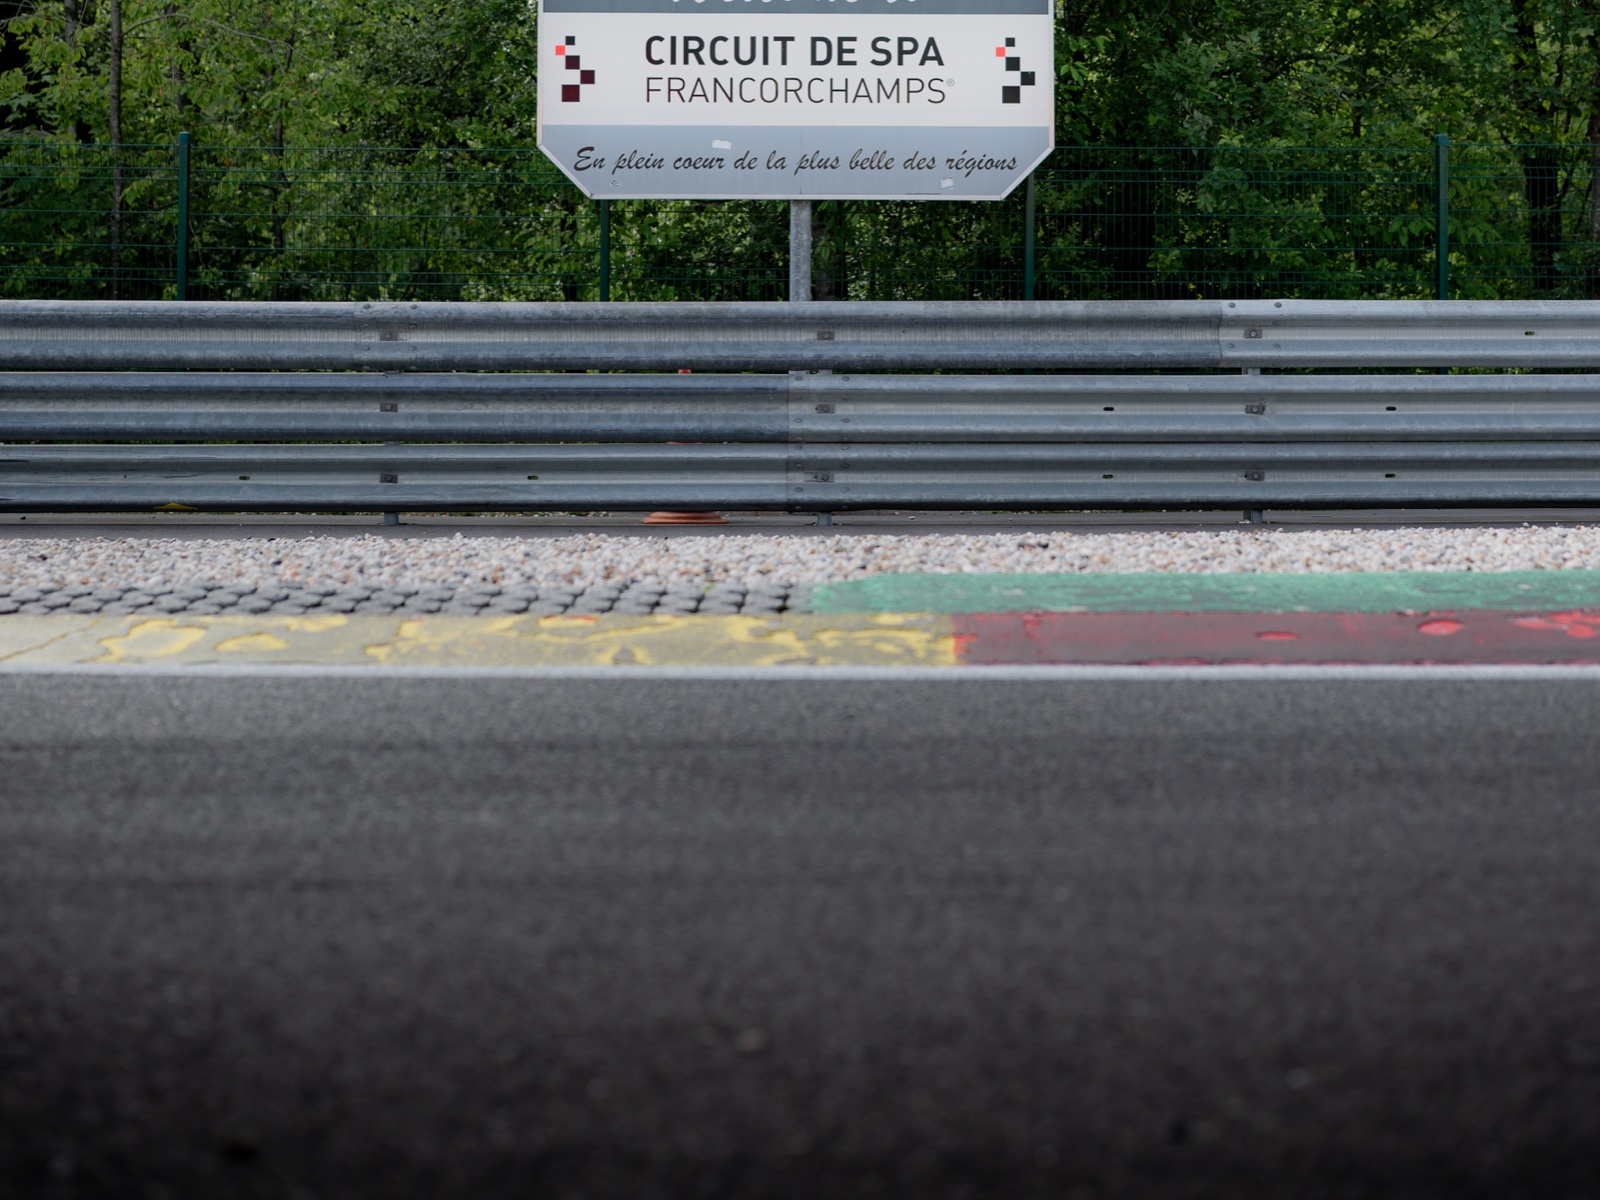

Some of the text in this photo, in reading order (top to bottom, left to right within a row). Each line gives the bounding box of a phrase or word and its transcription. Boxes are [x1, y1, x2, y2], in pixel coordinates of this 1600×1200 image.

[645, 35, 945, 67] CIRCUIT DE SPA
[573, 146, 1018, 178] En plein coeur de la plus belle des régions
